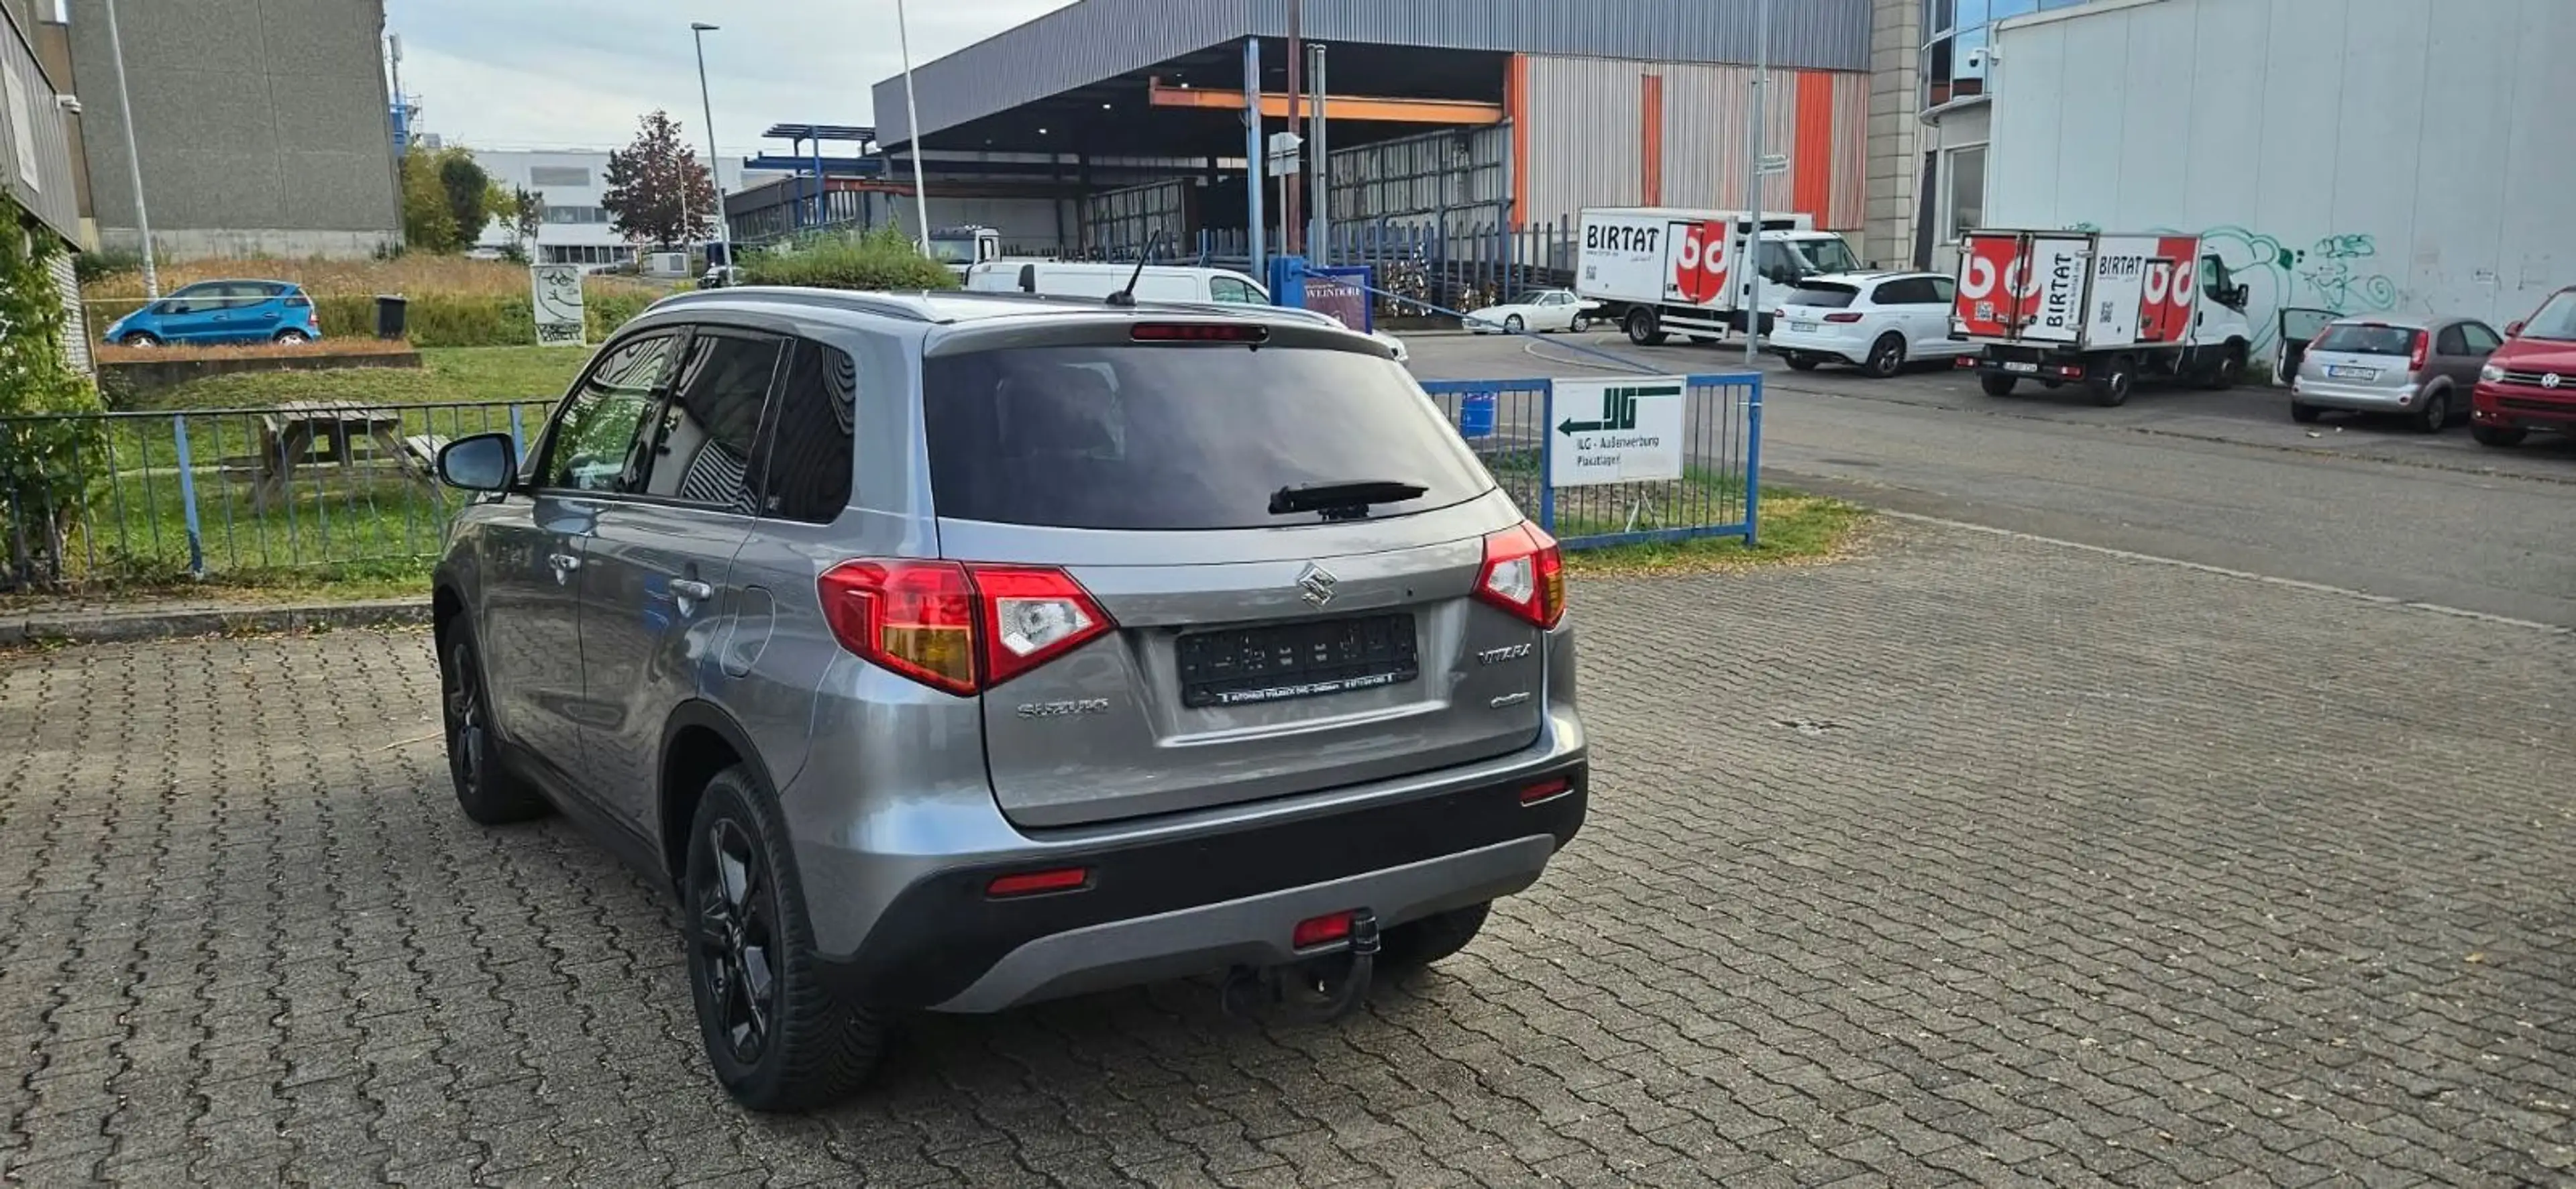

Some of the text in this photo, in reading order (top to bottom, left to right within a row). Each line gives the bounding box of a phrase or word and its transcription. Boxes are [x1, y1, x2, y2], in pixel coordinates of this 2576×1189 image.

[1587, 225, 1660, 253] BIRTAT
[2099, 256, 2143, 275] BIRTAT
[2047, 252, 2072, 327] BIRTAT
[1477, 643, 1532, 665] VITARA
[1018, 698, 1109, 720] SUZUKI
